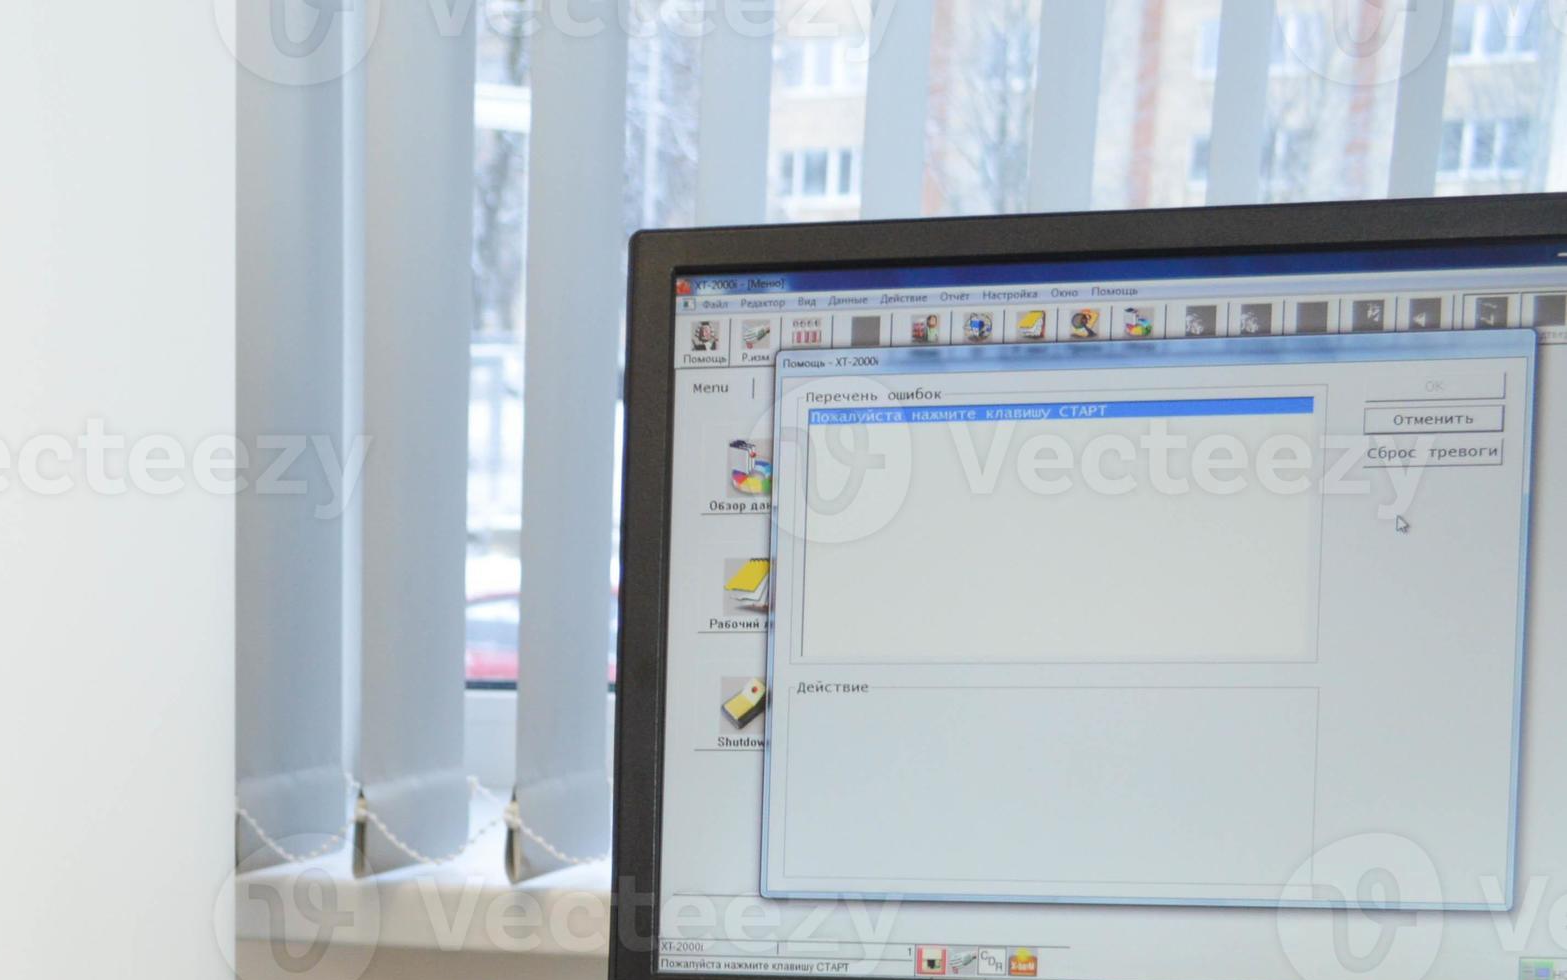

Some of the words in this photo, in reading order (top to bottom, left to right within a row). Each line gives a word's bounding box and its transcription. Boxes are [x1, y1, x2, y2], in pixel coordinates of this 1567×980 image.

[982, 289, 1038, 301] Настройка
[1051, 288, 1079, 298] Окно
[1091, 286, 1139, 297] Помощь
[702, 299, 729, 309] Файл
[740, 298, 786, 310] Редактор
[797, 296, 817, 307] Вид
[827, 295, 868, 306] Данные
[880, 294, 928, 305] Действие
[684, 354, 727, 364] Помощь
[783, 358, 825, 369] Помощь
[693, 383, 729, 394] Menu
[806, 391, 878, 404] Перечень
[888, 387, 942, 401] ошибок
[811, 409, 902, 424] Пожалуйста
[912, 409, 976, 421] нажмите
[986, 407, 1051, 420] клавишу
[1059, 405, 1107, 417] СТАРТ
[1393, 414, 1474, 426] Отменить
[1367, 446, 1416, 462] Сброс
[1430, 446, 1498, 460] тревоги
[709, 500, 746, 513] Обзор
[709, 618, 760, 630] Рабочий
[796, 681, 869, 694] Действие
[661, 958, 722, 970] Пожалуйста
[724, 961, 769, 971] нажмите
[772, 963, 814, 973] клавишу
[816, 962, 850, 972] СТАРТ
